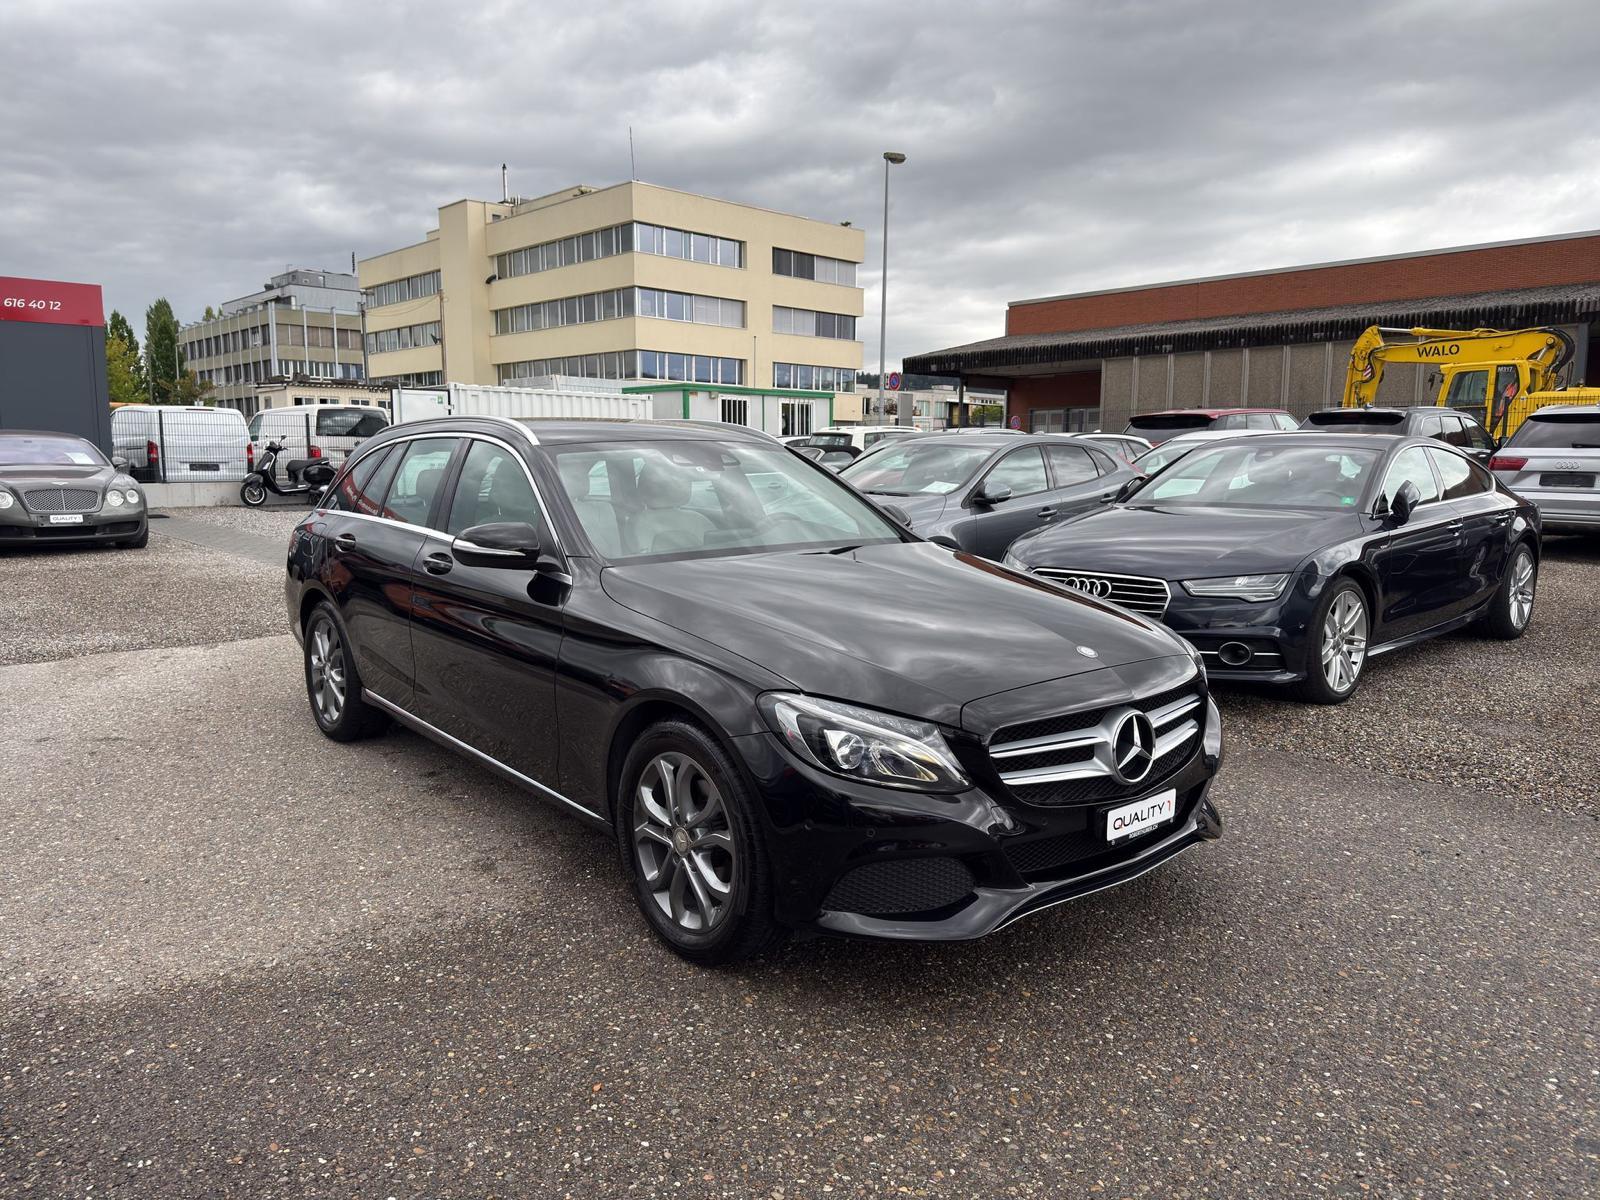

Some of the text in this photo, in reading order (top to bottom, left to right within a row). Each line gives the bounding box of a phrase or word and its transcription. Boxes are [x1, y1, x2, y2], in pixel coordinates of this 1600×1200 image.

[4, 298, 61, 310] 616 40 12
[1417, 344, 1460, 358] WALO
[1113, 801, 1165, 831] QUALITY
[1167, 800, 1171, 812] 1
